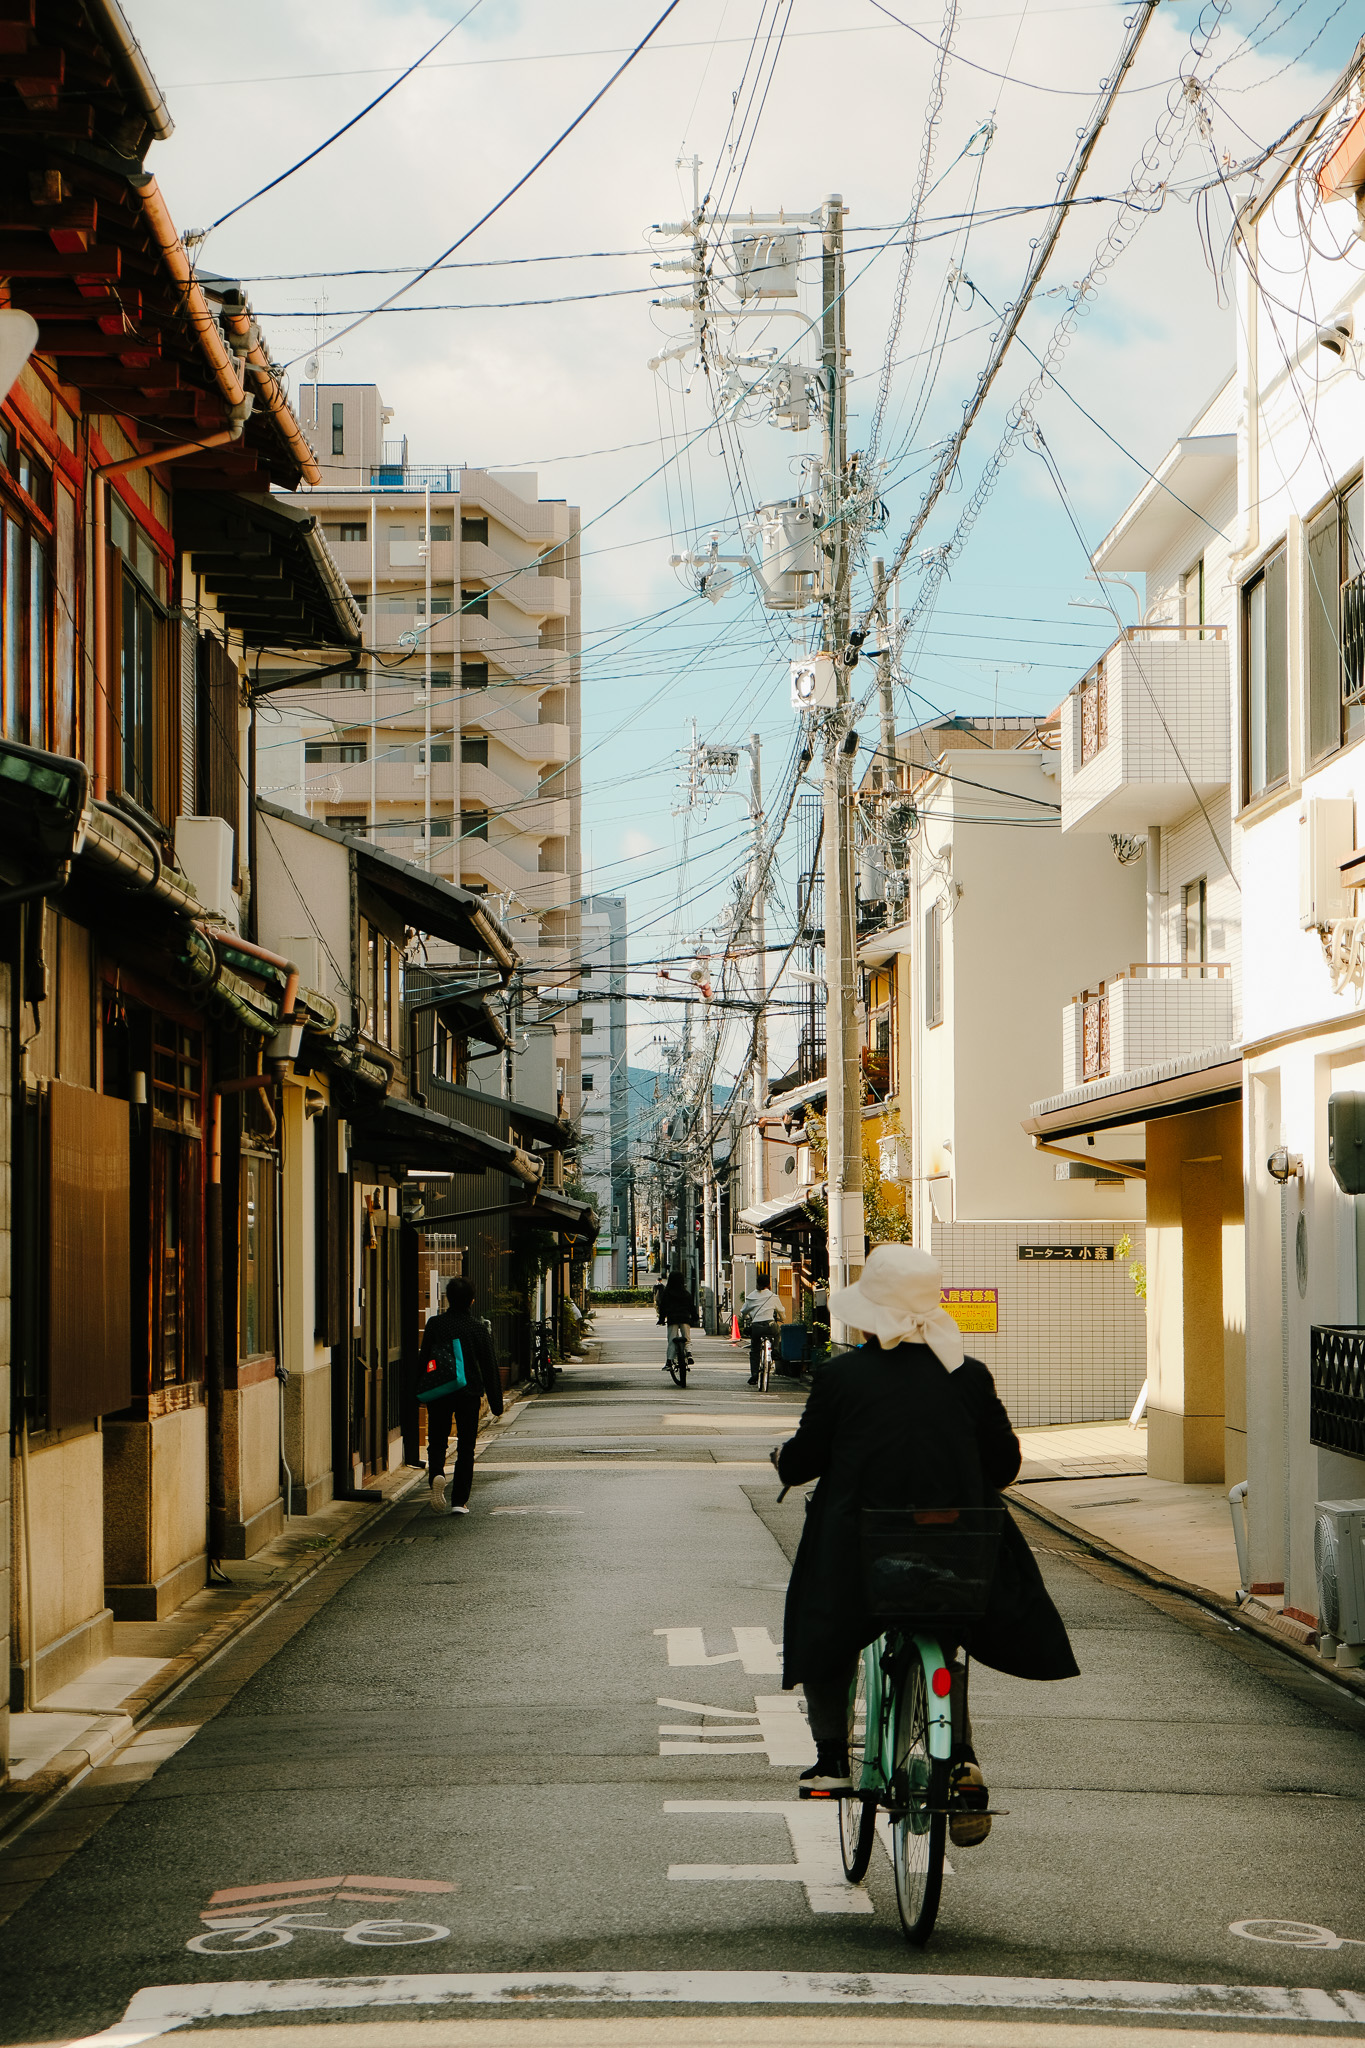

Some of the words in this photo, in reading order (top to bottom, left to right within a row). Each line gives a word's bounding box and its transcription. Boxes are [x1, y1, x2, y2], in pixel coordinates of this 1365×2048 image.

[1025, 1248, 1073, 1258] コータース
[1078, 1246, 1108, 1260] 小森
[939, 1290, 996, 1302] 入居者募集
